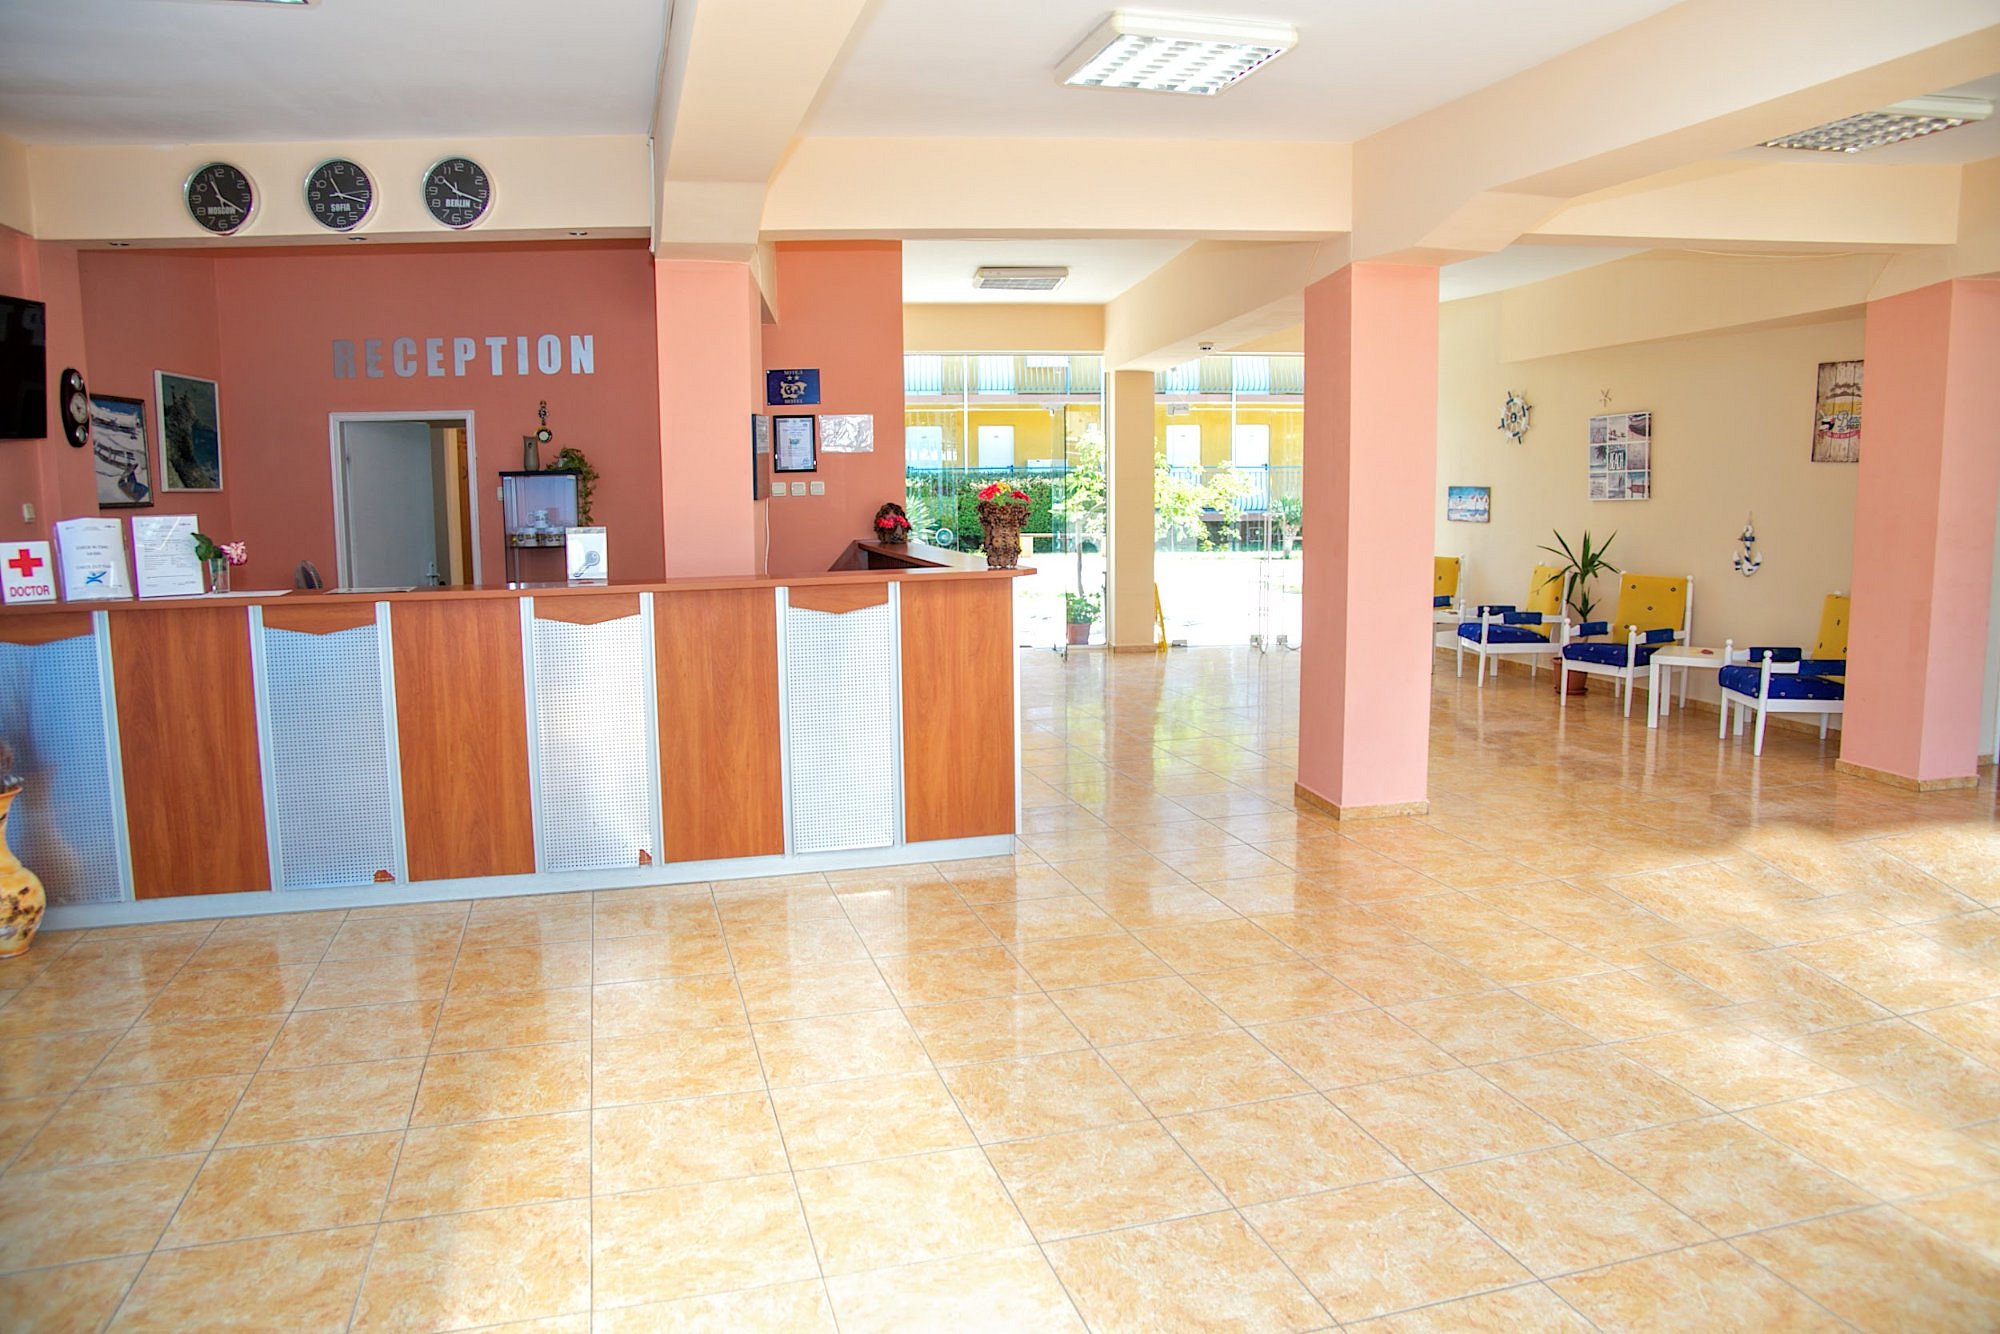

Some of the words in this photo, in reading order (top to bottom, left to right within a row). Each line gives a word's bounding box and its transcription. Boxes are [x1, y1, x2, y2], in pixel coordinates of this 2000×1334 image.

[335, 166, 344, 174] 12
[455, 163, 464, 171] 12
[214, 168, 224, 177] 12
[324, 170, 331, 178] 11
[315, 180, 327, 188] 10
[356, 177, 365, 185] 2
[434, 176, 445, 184] 10
[475, 176, 483, 184] 2
[196, 183, 207, 192] 10
[237, 180, 245, 189] 2
[361, 190, 369, 198] 3
[429, 187, 438, 195] 9
[478, 190, 486, 198] 3
[192, 195, 202, 204] 9
[241, 193, 250, 202] 3
[312, 191, 320, 200] 9
[432, 199, 440, 207] 8
[445, 199, 471, 208] BERLIN
[197, 207, 205, 215] 8
[316, 204, 325, 212] 8
[331, 203, 351, 212] SOFIA
[326, 213, 334, 221] 7
[349, 212, 358, 220] 5
[442, 209, 450, 218] 7
[452, 213, 461, 222] 6
[464, 210, 473, 219] 5
[208, 216, 216, 225] 7
[230, 216, 239, 224] 5
[337, 216, 346, 225] 6
[219, 220, 228, 229] 6
[332, 334, 595, 378] RECEPTION
[10, 585, 50, 597] DOCTOR
